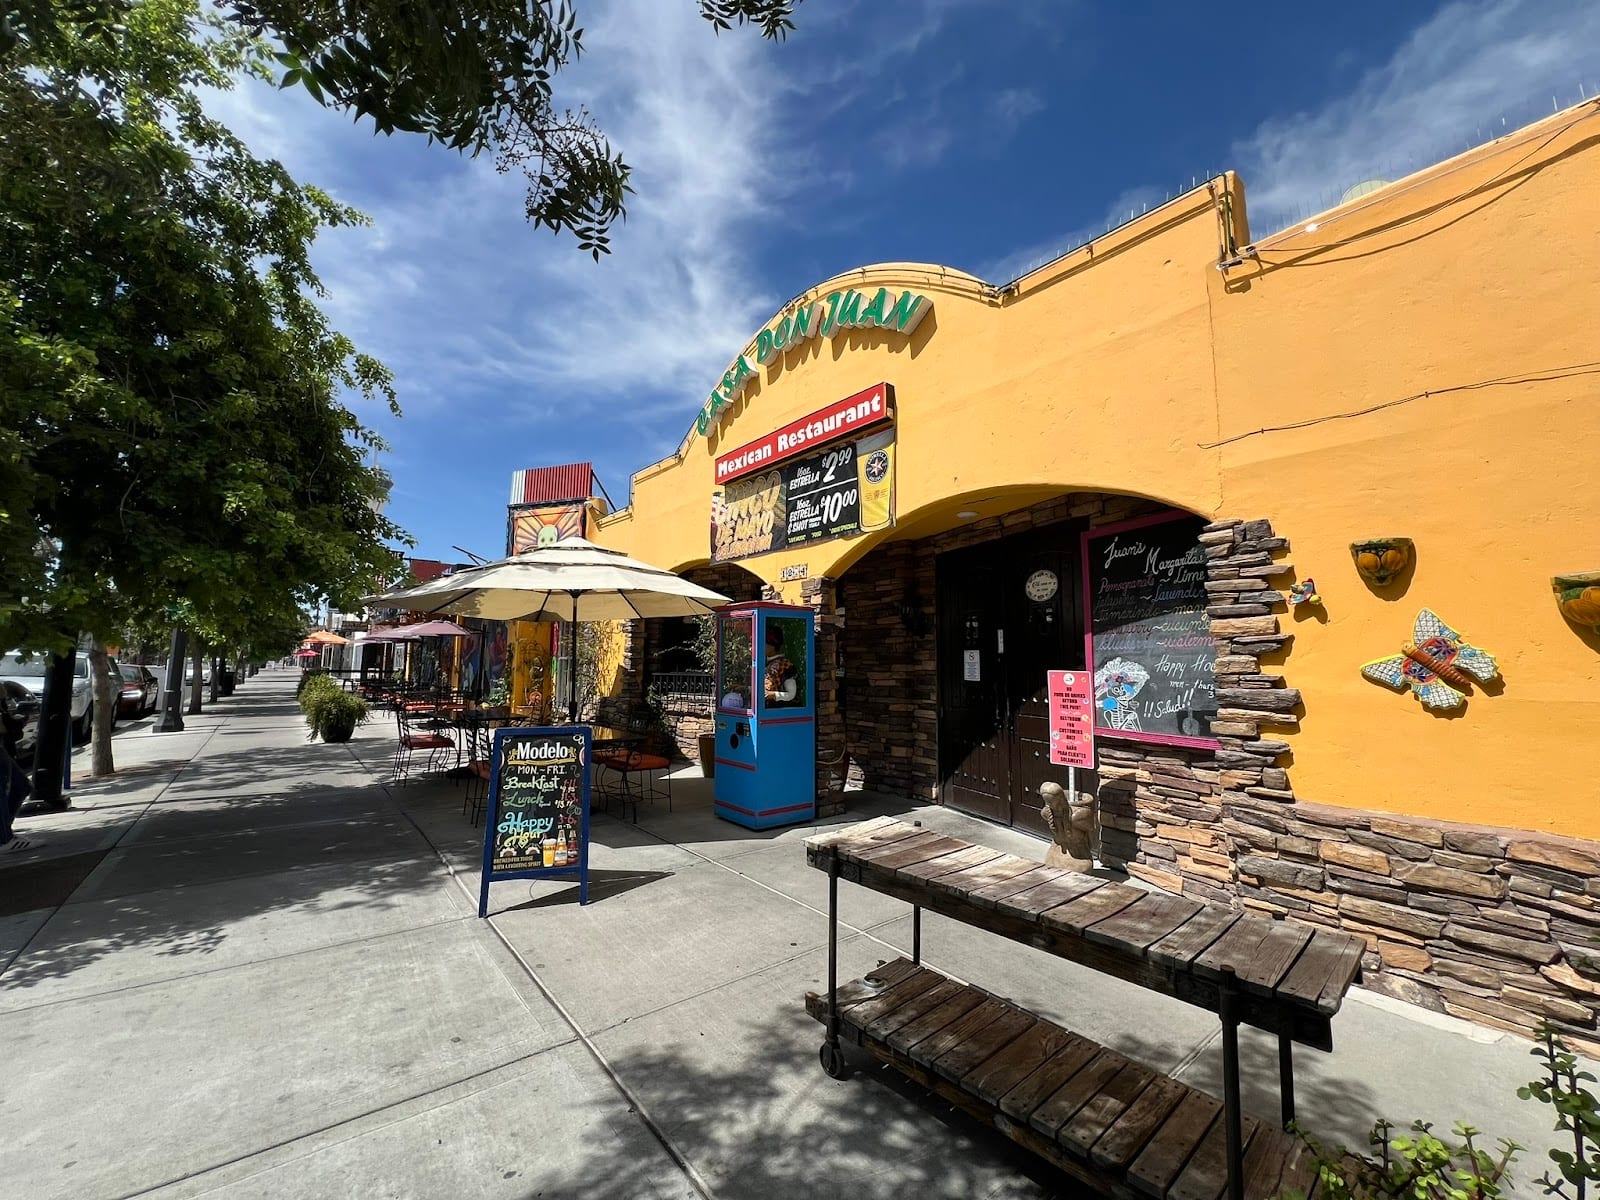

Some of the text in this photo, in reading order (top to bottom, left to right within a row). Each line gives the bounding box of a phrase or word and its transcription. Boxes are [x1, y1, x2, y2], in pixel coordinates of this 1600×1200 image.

[697, 288, 927, 437] CASA DON JUAN
[717, 393, 881, 478] Mexican Restaurant
[789, 471, 820, 490] ESTRELLA
[789, 504, 820, 522] ESTRELLA
[716, 510, 775, 547] DE MAYO
[1143, 547, 1205, 577] Margaritas
[1173, 566, 1205, 585] Lime
[1154, 654, 1216, 679] Happy Hou
[516, 742, 568, 760] Modelo
[503, 775, 560, 790] Breakfast
[503, 791, 545, 807] Lunch
[497, 812, 554, 833] Happy
[504, 828, 541, 848] Hour
